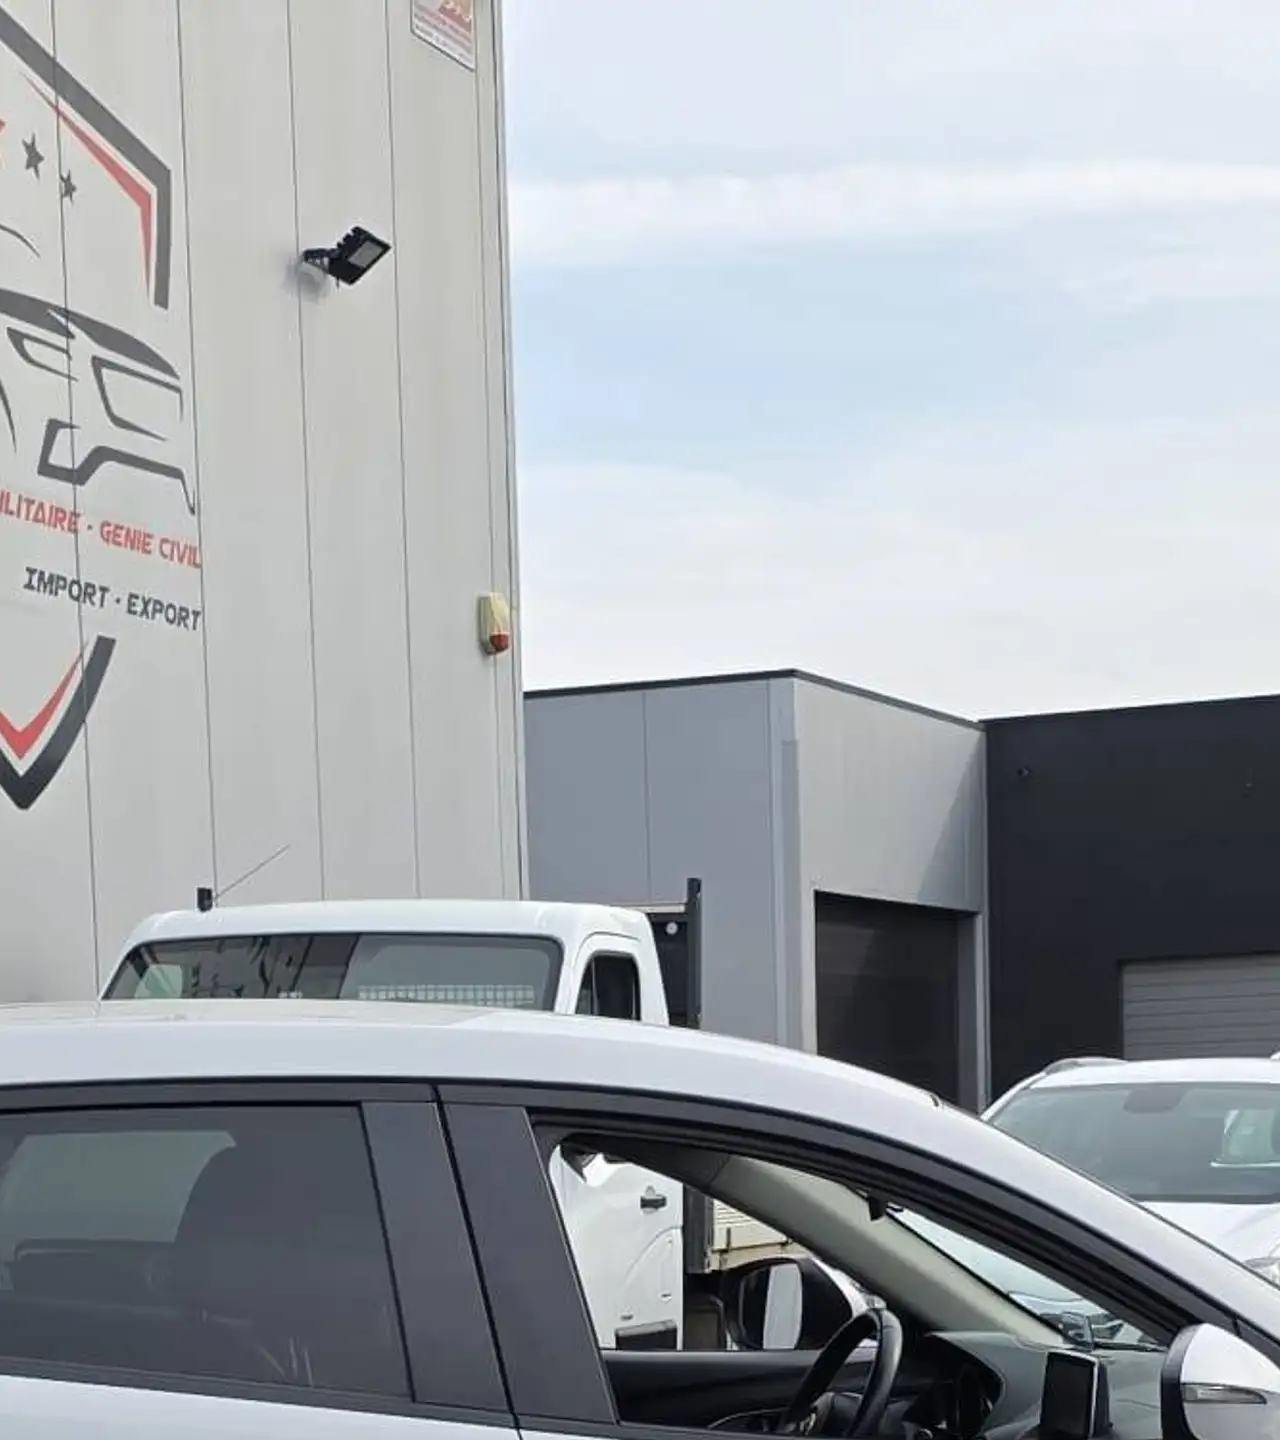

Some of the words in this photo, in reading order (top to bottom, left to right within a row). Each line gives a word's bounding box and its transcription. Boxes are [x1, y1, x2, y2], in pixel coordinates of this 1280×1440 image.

[99, 520, 154, 555] GENIE
[158, 537, 202, 569] CIVIL
[23, 566, 110, 609] IMPORT
[126, 591, 202, 631] EXPORT
